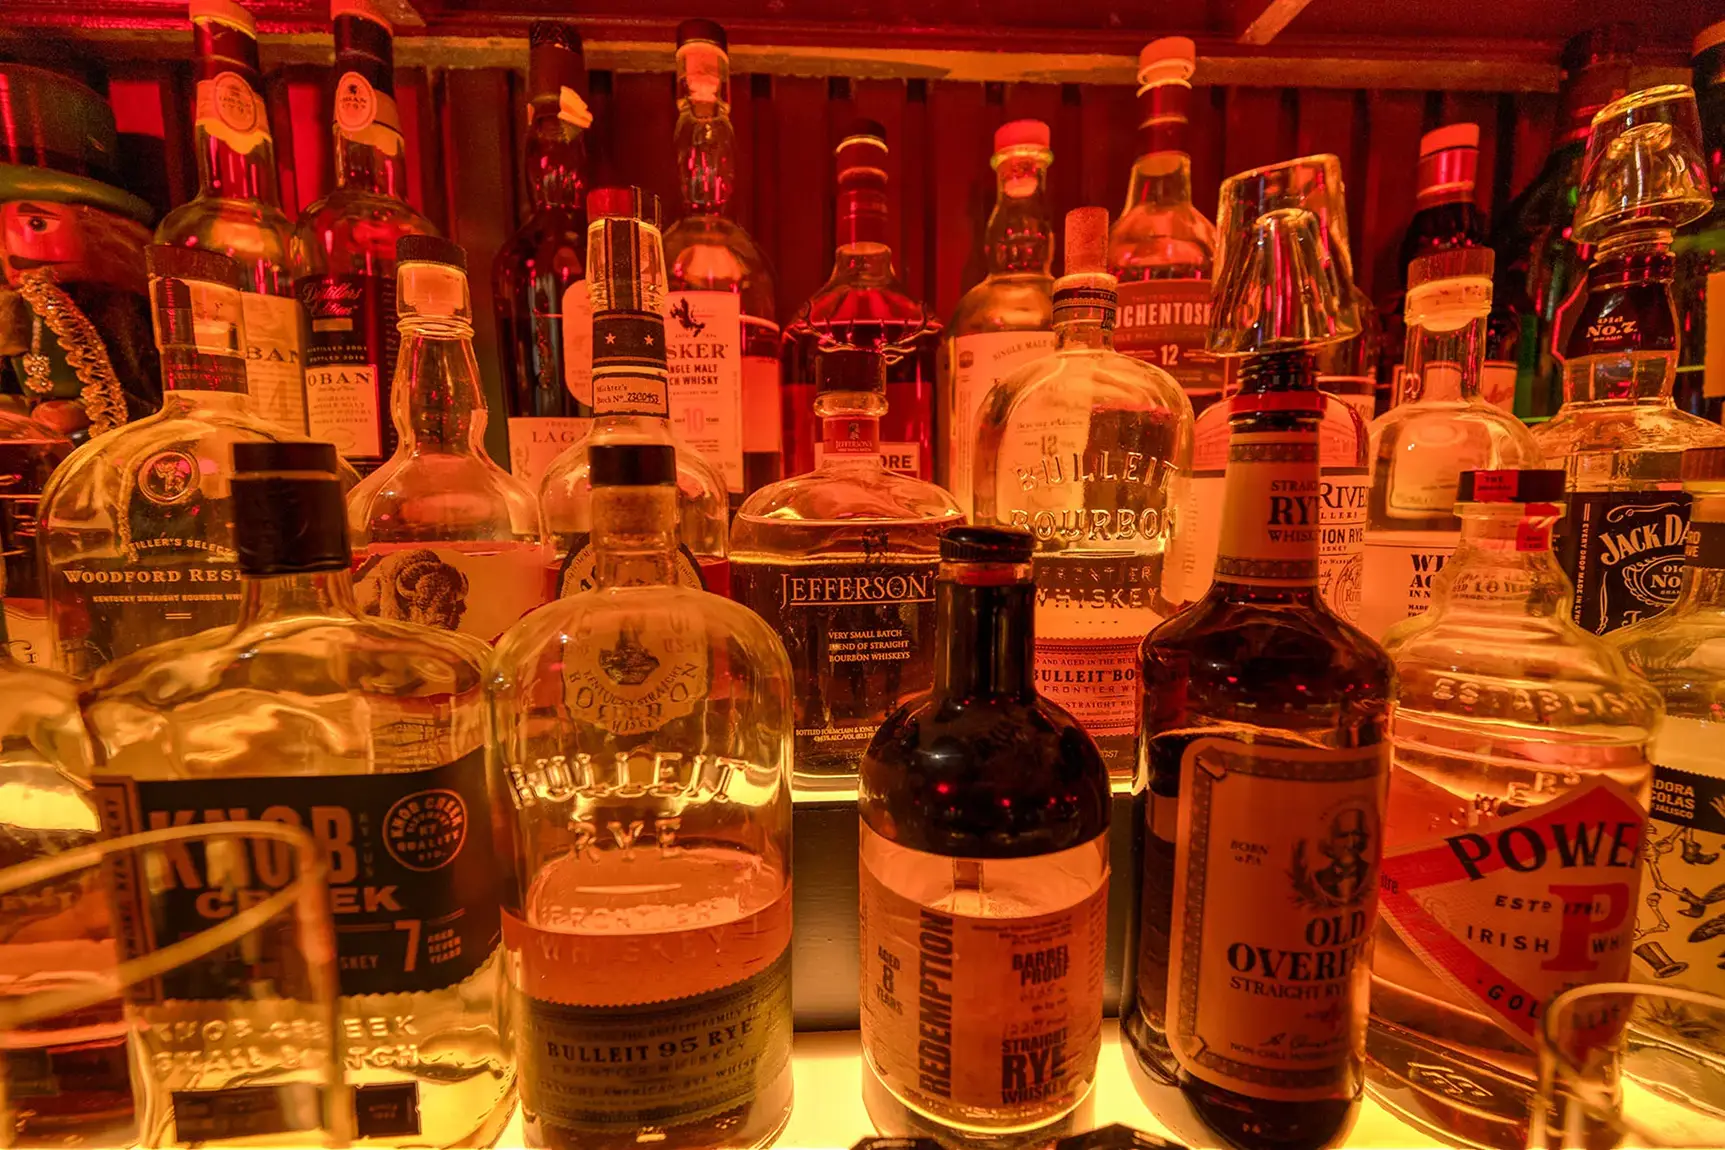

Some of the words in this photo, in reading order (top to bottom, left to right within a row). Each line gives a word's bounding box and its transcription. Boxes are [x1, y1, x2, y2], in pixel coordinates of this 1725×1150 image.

[247, 346, 299, 364] BAN
[666, 344, 726, 359] SKER
[1160, 344, 1179, 365] 12
[308, 372, 373, 387] OBAN
[694, 364, 718, 373] MALT
[669, 377, 680, 385] CH
[683, 376, 719, 385] WHISKY
[1015, 450, 1180, 494] BULLEIT
[1011, 508, 1178, 541] BOURBON
[1348, 528, 1363, 543] RYE
[1581, 523, 1590, 548] EVERY
[1599, 523, 1663, 566] JACK
[1664, 514, 1691, 546] DA
[1579, 549, 1587, 571] DROP
[63, 570, 181, 584] WOODFORD
[137, 594, 180, 602] STRAIGHT
[182, 594, 224, 602] BOURBON
[828, 632, 849, 640] VERY
[850, 631, 875, 639] SMALL
[876, 630, 903, 638] BATCH
[870, 641, 909, 650] STRAIGHT
[829, 654, 869, 662] BOURBON
[871, 652, 911, 661] WHISKEYS
[1063, 658, 1084, 666] AGED
[1044, 686, 1116, 694] FRONTIER
[1656, 805, 1694, 819] JALISCO
[149, 806, 357, 889] KNOB
[568, 818, 682, 862] RYE
[1444, 821, 1638, 882] POWE
[1305, 910, 1366, 947] OLD
[1467, 925, 1549, 953] IRISH
[395, 919, 421, 972] 7
[340, 955, 379, 970] SKEY
[883, 964, 894, 993] 8
[1230, 976, 1319, 999] STRAIGHT
[919, 909, 953, 1100] REDEMPTION
[1488, 985, 1541, 1018] GOL
[545, 1041, 649, 1063] BULLEIT
[659, 1036, 700, 1058] 95
[708, 1019, 753, 1048] RYE
[1002, 1046, 1066, 1089] RYE
